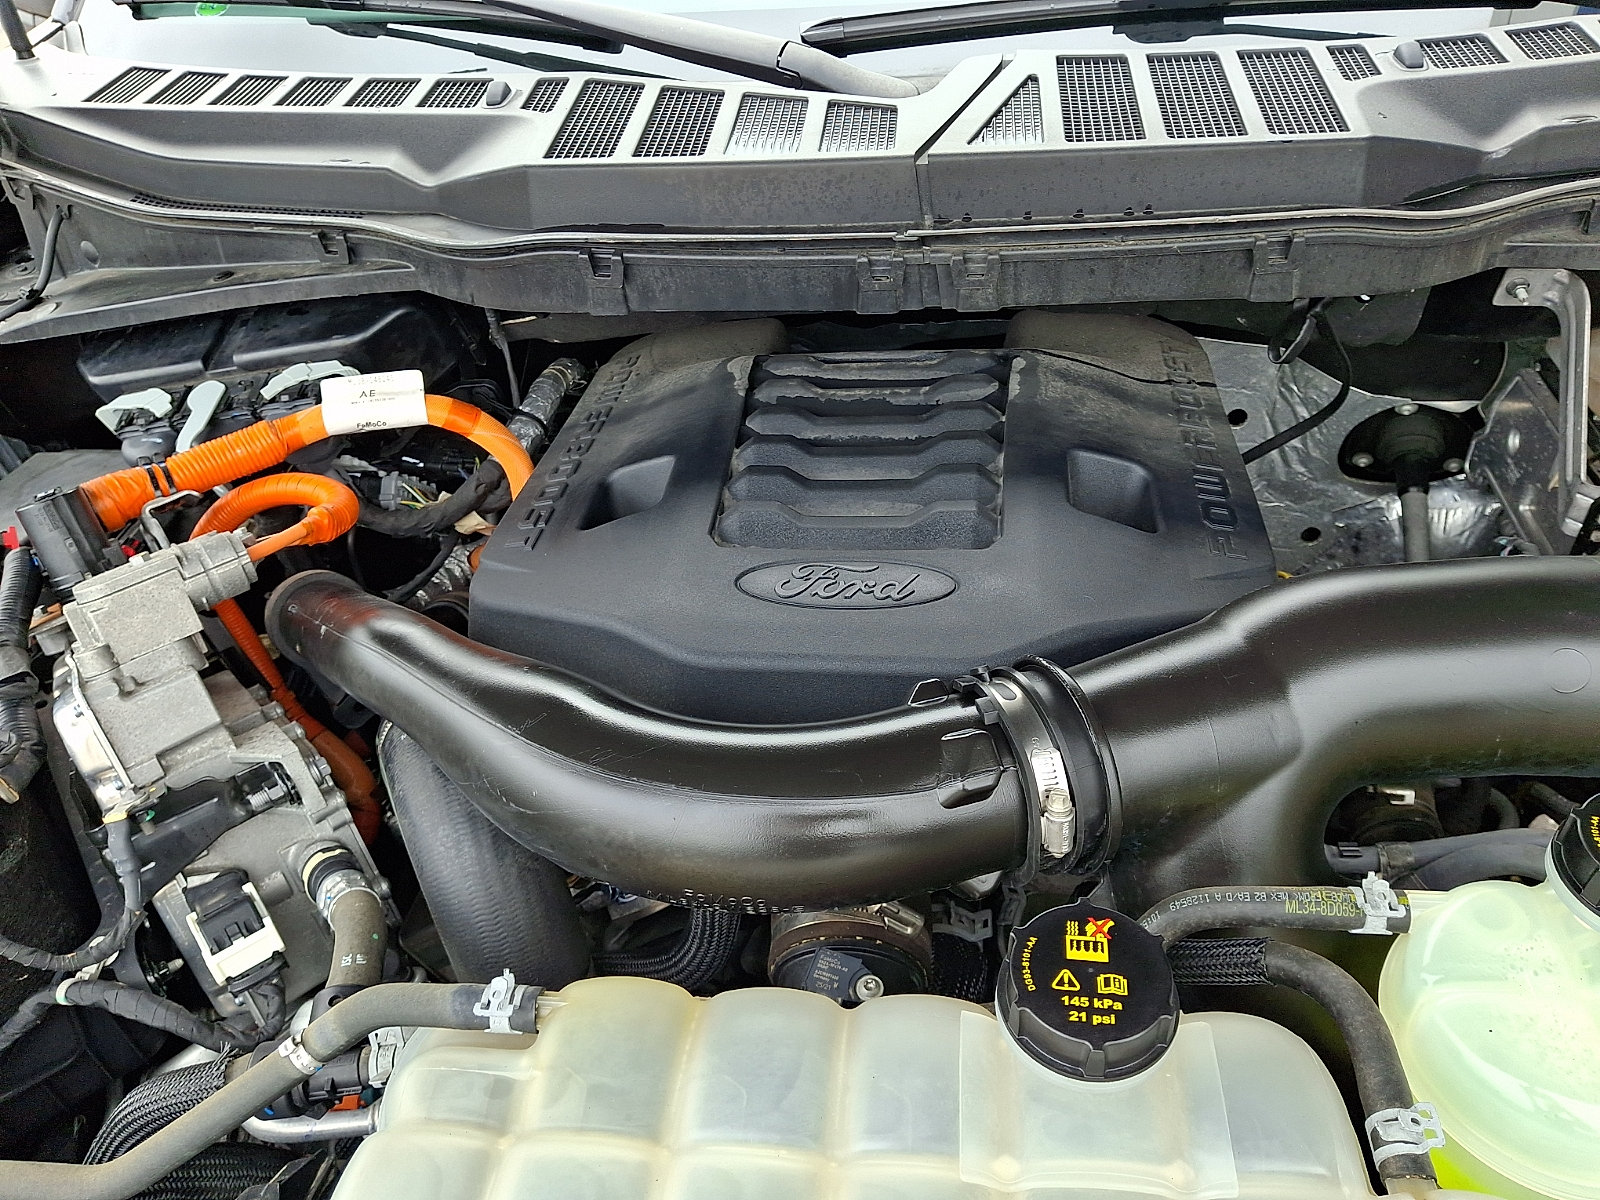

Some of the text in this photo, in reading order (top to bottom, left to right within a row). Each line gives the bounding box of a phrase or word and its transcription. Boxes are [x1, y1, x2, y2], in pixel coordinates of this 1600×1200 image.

[356, 420, 387, 429] FoMoCo
[774, 562, 920, 601] Ford
[1021, 936, 1038, 992] DG93-8101-AA
[1061, 995, 1123, 1011] 145 kPa
[1068, 1010, 1116, 1026] 21 psi
